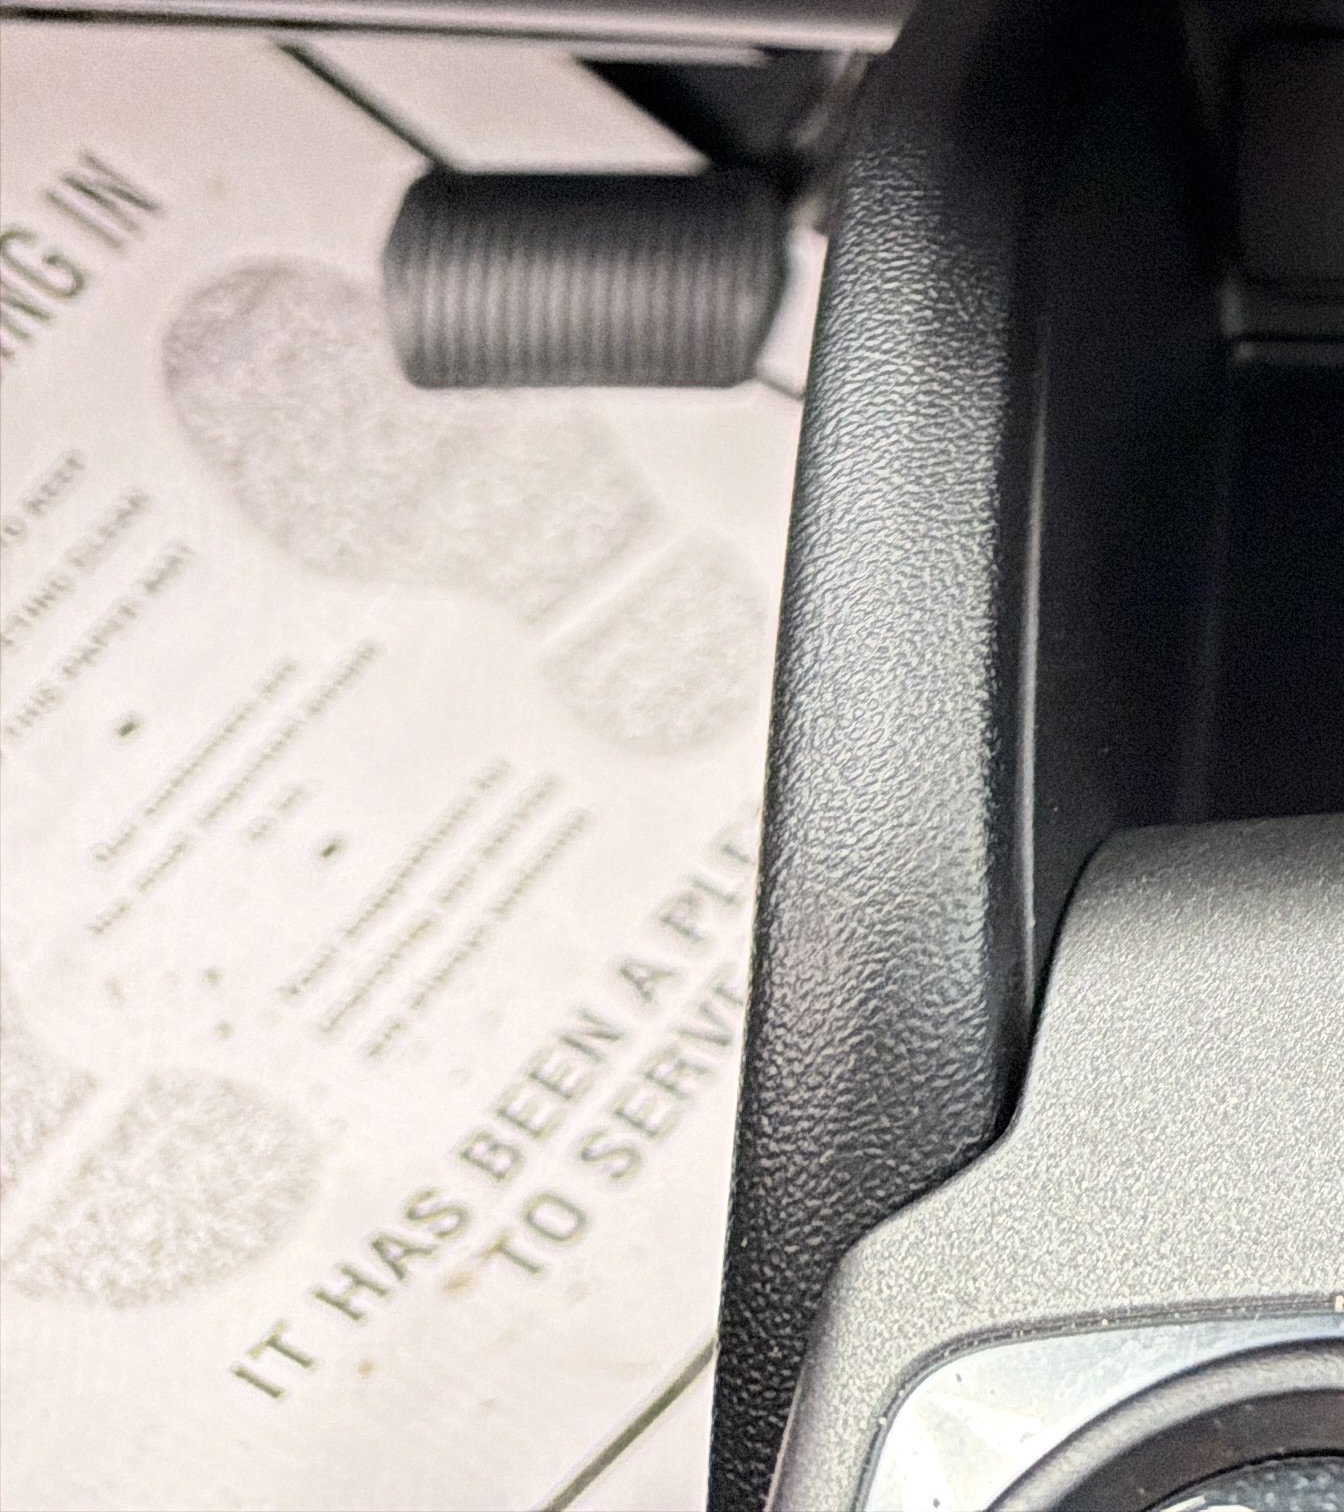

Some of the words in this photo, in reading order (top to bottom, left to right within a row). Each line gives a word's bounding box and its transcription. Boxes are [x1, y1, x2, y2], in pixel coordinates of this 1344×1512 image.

[46, 148, 162, 250] IN
[230, 1318, 317, 1401] IT
[311, 1186, 471, 1324] HAS
[459, 1006, 625, 1182] BEEN
[617, 954, 682, 1006] A
[656, 804, 757, 946] PLE
[487, 1188, 590, 1281] TO
